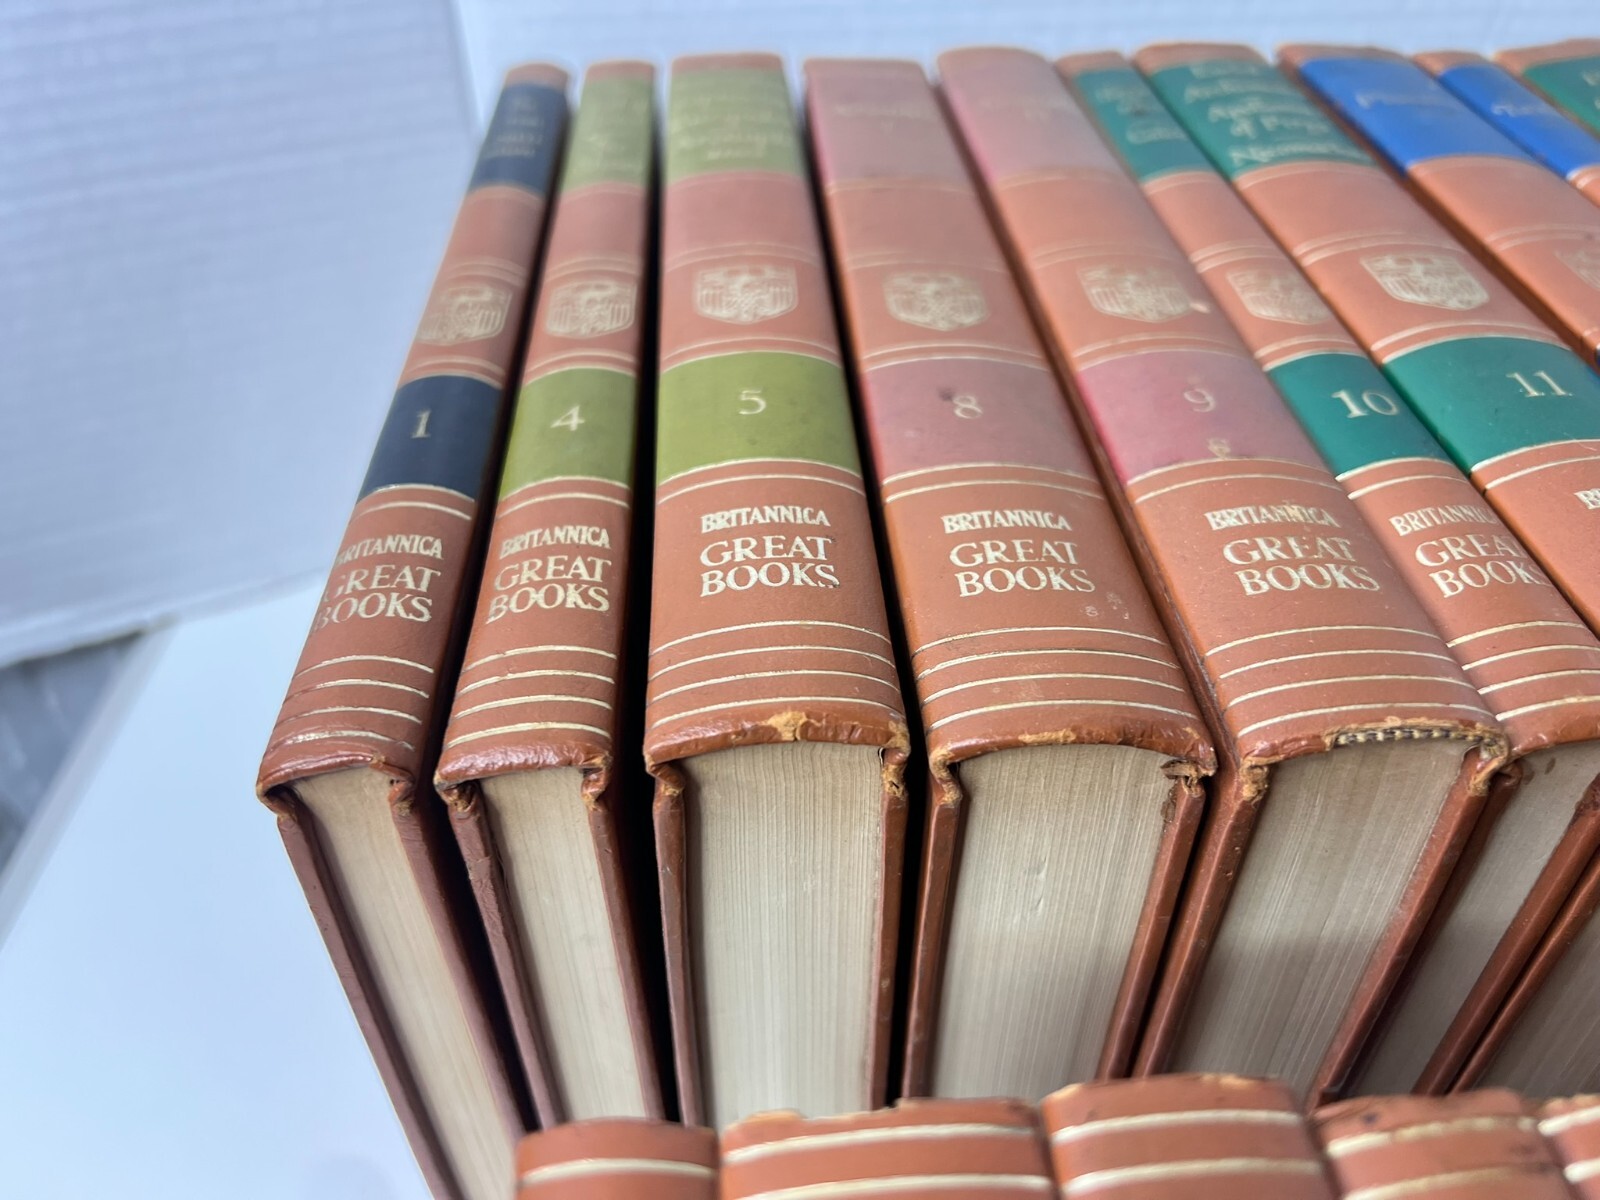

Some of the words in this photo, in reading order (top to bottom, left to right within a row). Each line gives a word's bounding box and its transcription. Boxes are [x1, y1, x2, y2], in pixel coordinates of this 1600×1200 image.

[1506, 370, 1573, 398] 11
[738, 390, 767, 416] 5
[952, 394, 984, 420] 8
[1184, 387, 1217, 413] 9
[1331, 388, 1400, 418] 10
[411, 408, 432, 438] 1
[550, 405, 586, 431] 4
[700, 505, 831, 534] BRITANNICA
[941, 509, 1073, 534] BRITANNICA
[1203, 504, 1342, 531] BRITANNICA
[499, 525, 612, 559] BRITANNICA
[700, 535, 832, 567] GREAT
[949, 539, 1078, 567] GREAT
[1222, 536, 1357, 565] GREAT
[494, 555, 612, 591] GREAT
[700, 562, 840, 597] BOOKS
[954, 565, 1096, 598] BOOKS
[1234, 563, 1380, 596] BOOKS
[485, 583, 610, 625] BOOKS
